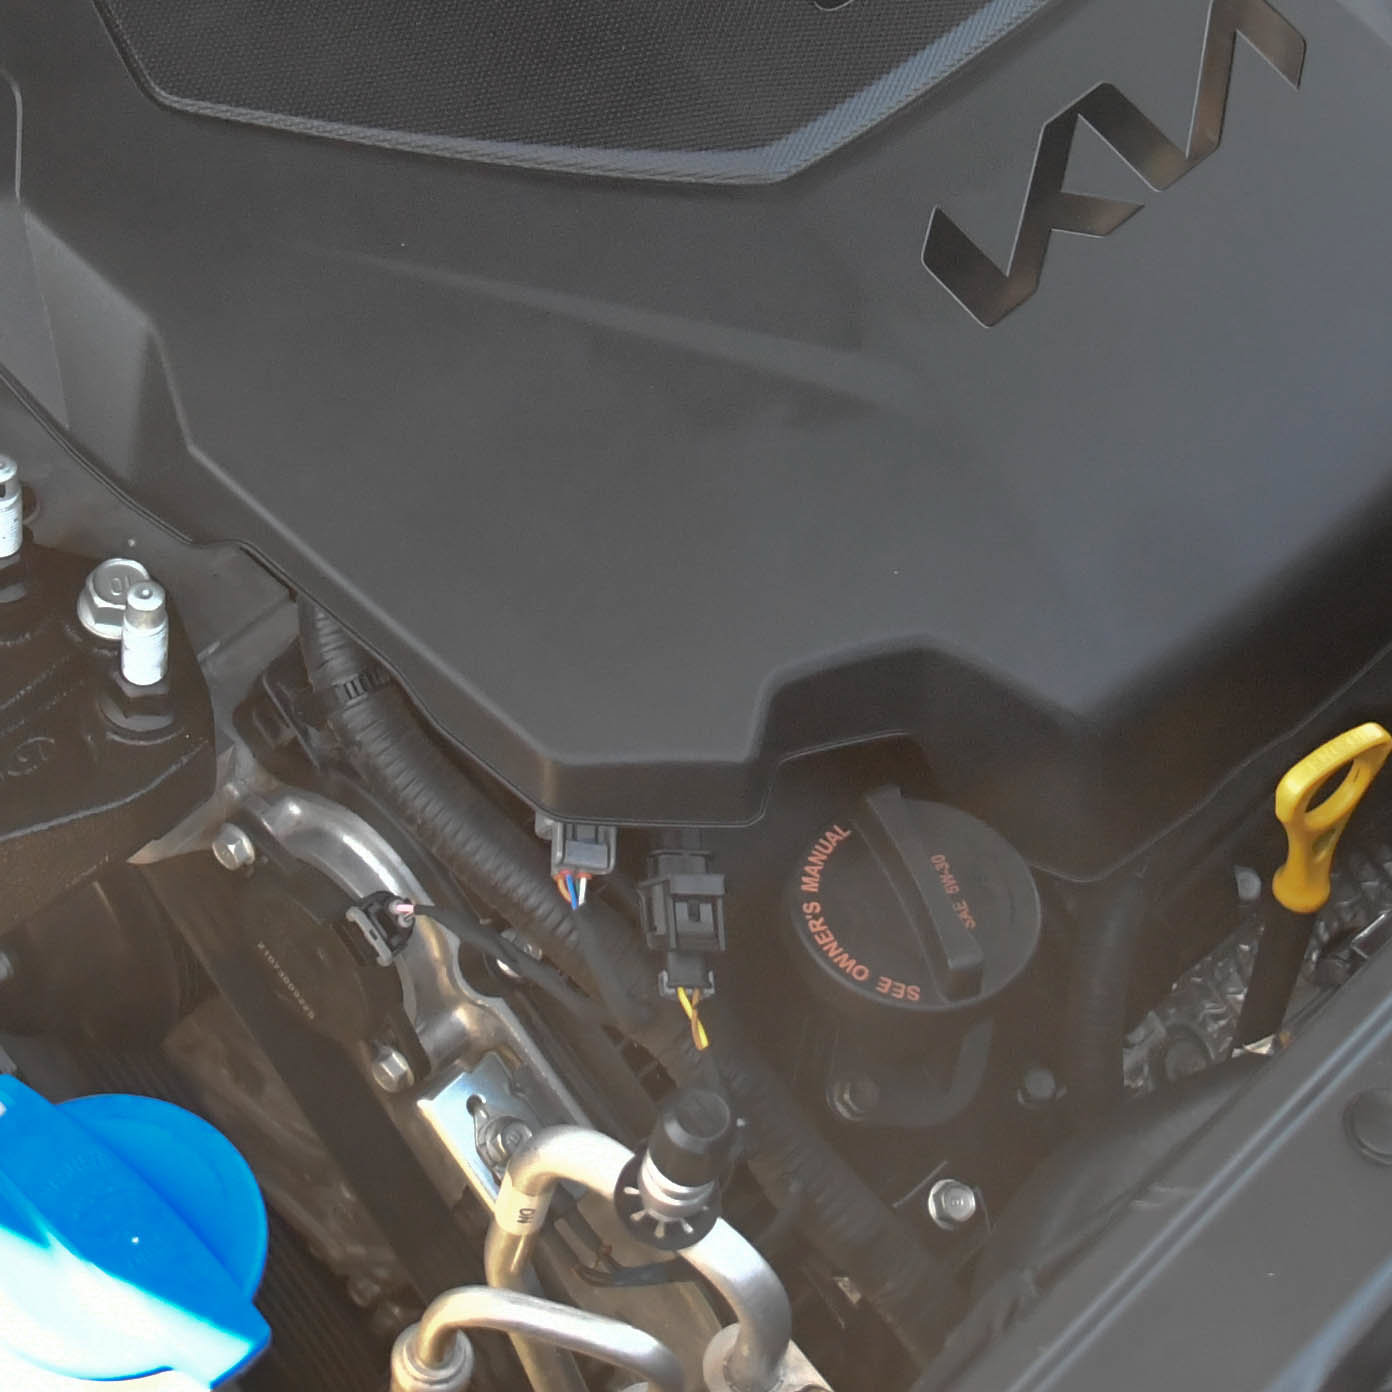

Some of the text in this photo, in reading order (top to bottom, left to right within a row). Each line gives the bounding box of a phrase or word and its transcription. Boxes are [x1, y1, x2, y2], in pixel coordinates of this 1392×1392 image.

[800, 823, 921, 1001] SEE OWNER'S MANUAL
[952, 899, 977, 930] SAE
